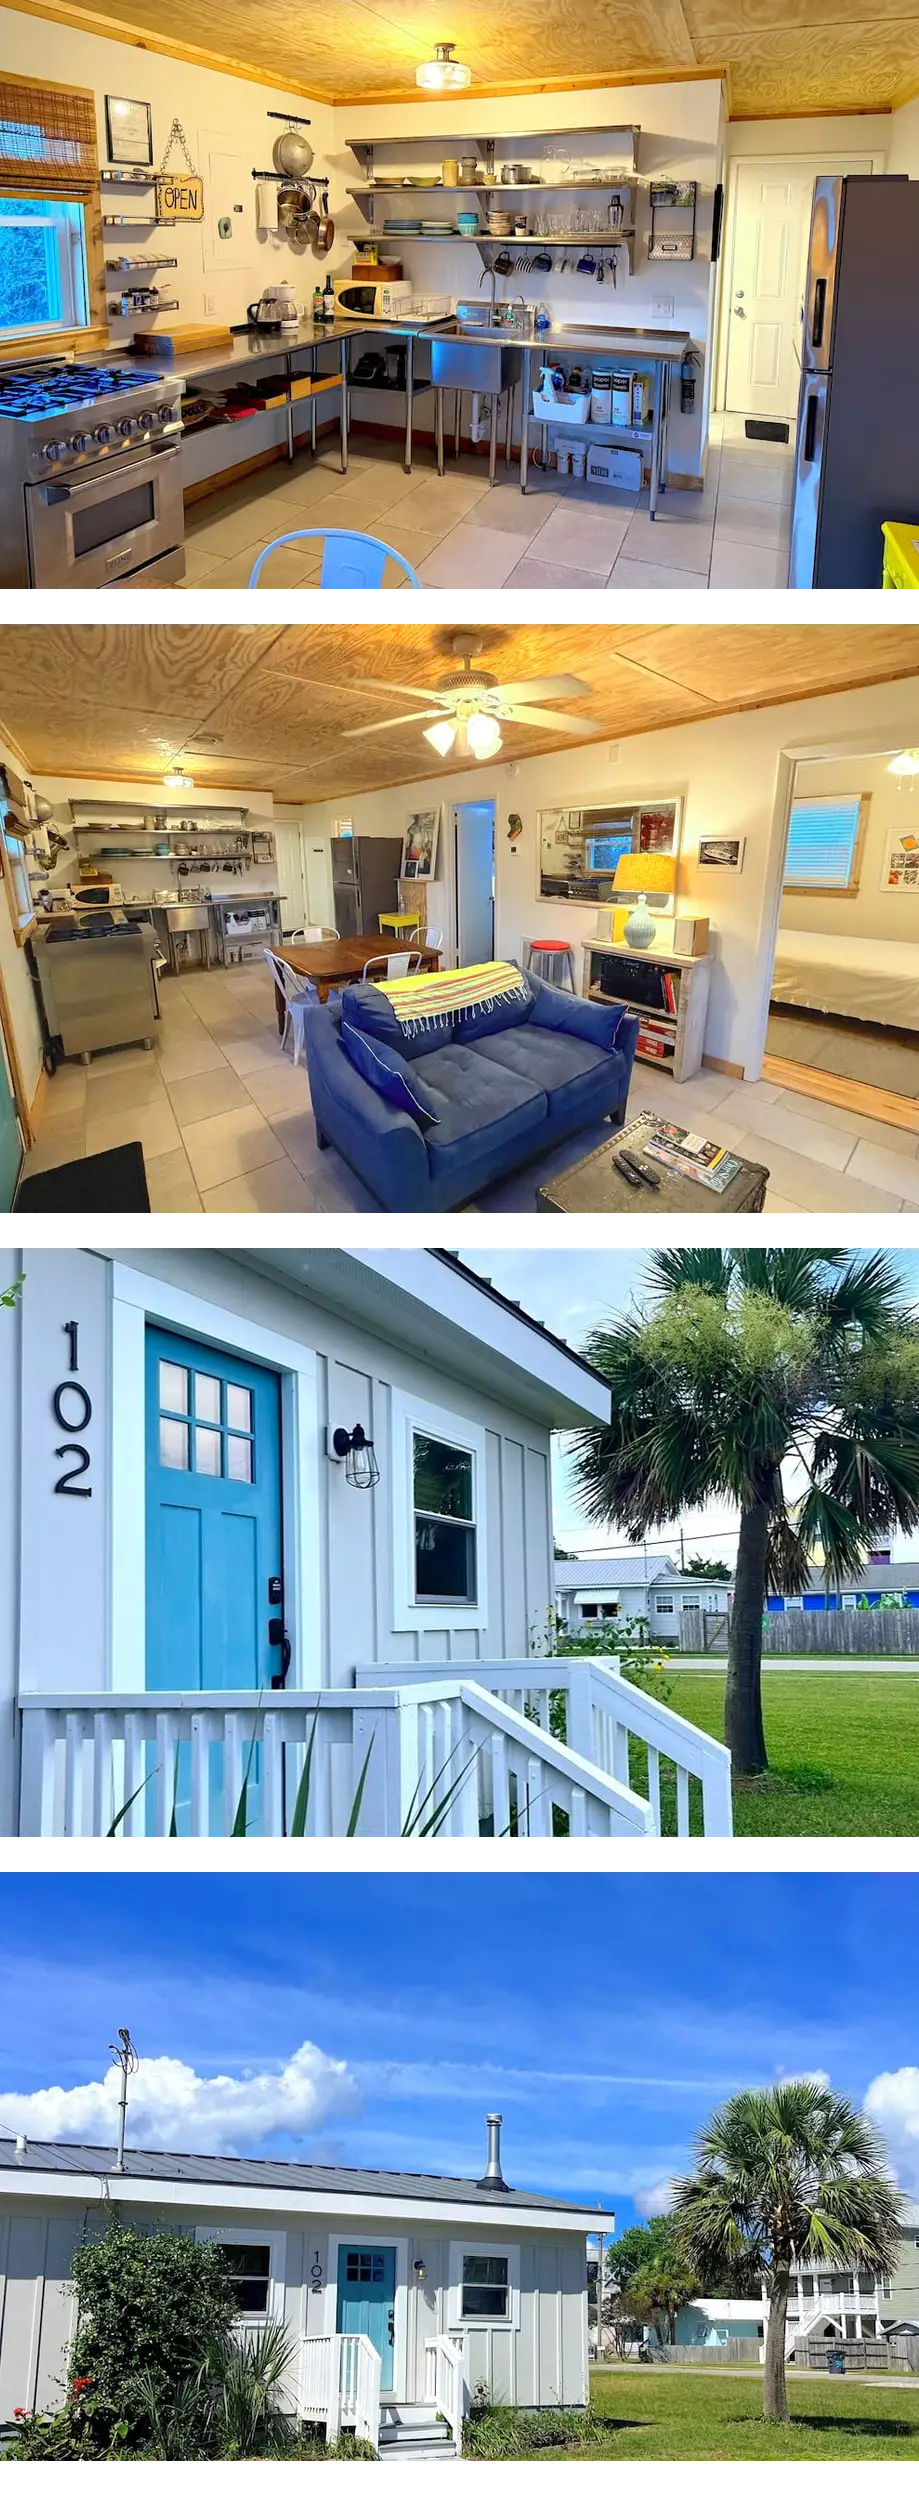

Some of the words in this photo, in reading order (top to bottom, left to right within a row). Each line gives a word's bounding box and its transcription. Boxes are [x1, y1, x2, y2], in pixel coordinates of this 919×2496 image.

[165, 187, 198, 210] OPEN
[53, 1321, 92, 1497] 102
[311, 2250, 322, 2294] 102
